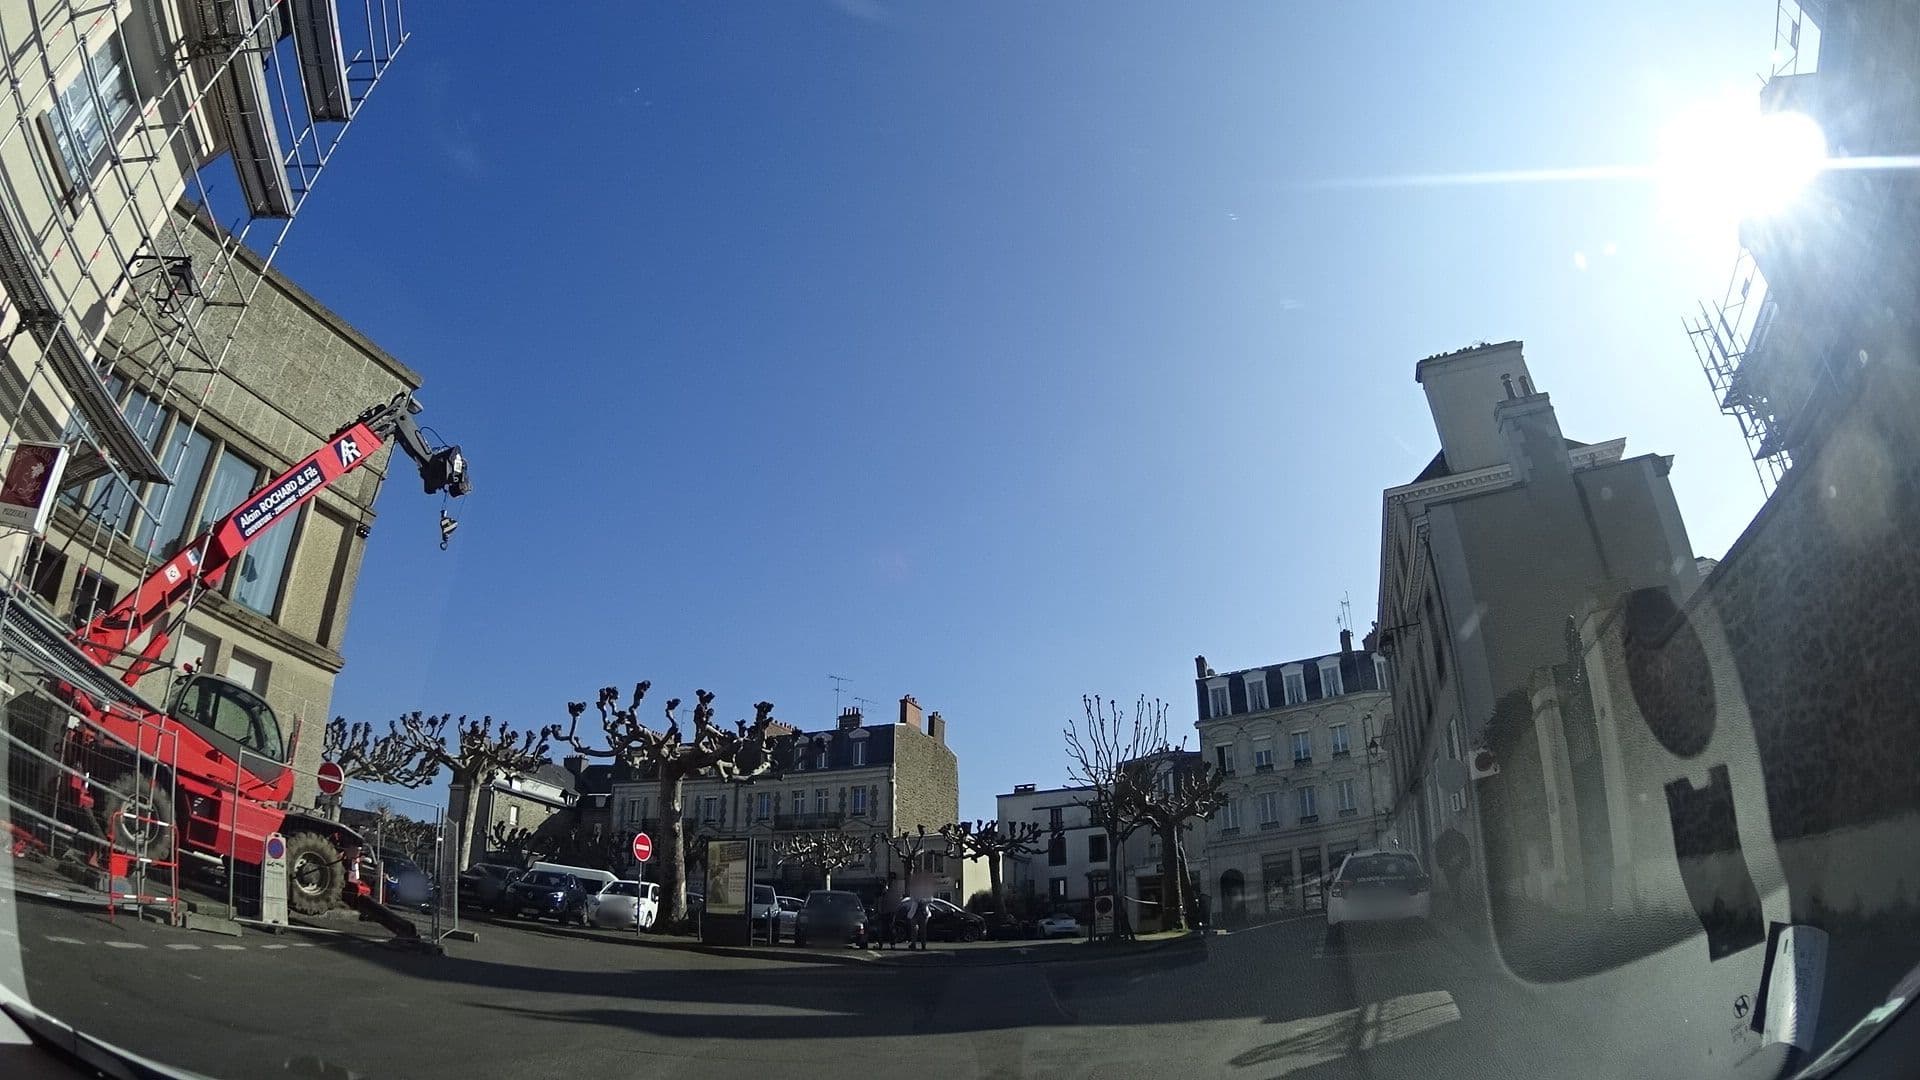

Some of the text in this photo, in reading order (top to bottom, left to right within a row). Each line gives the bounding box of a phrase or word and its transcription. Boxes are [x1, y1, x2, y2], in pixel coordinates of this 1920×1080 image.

[240, 466, 318, 528] Alain ROCHARD & Fils
